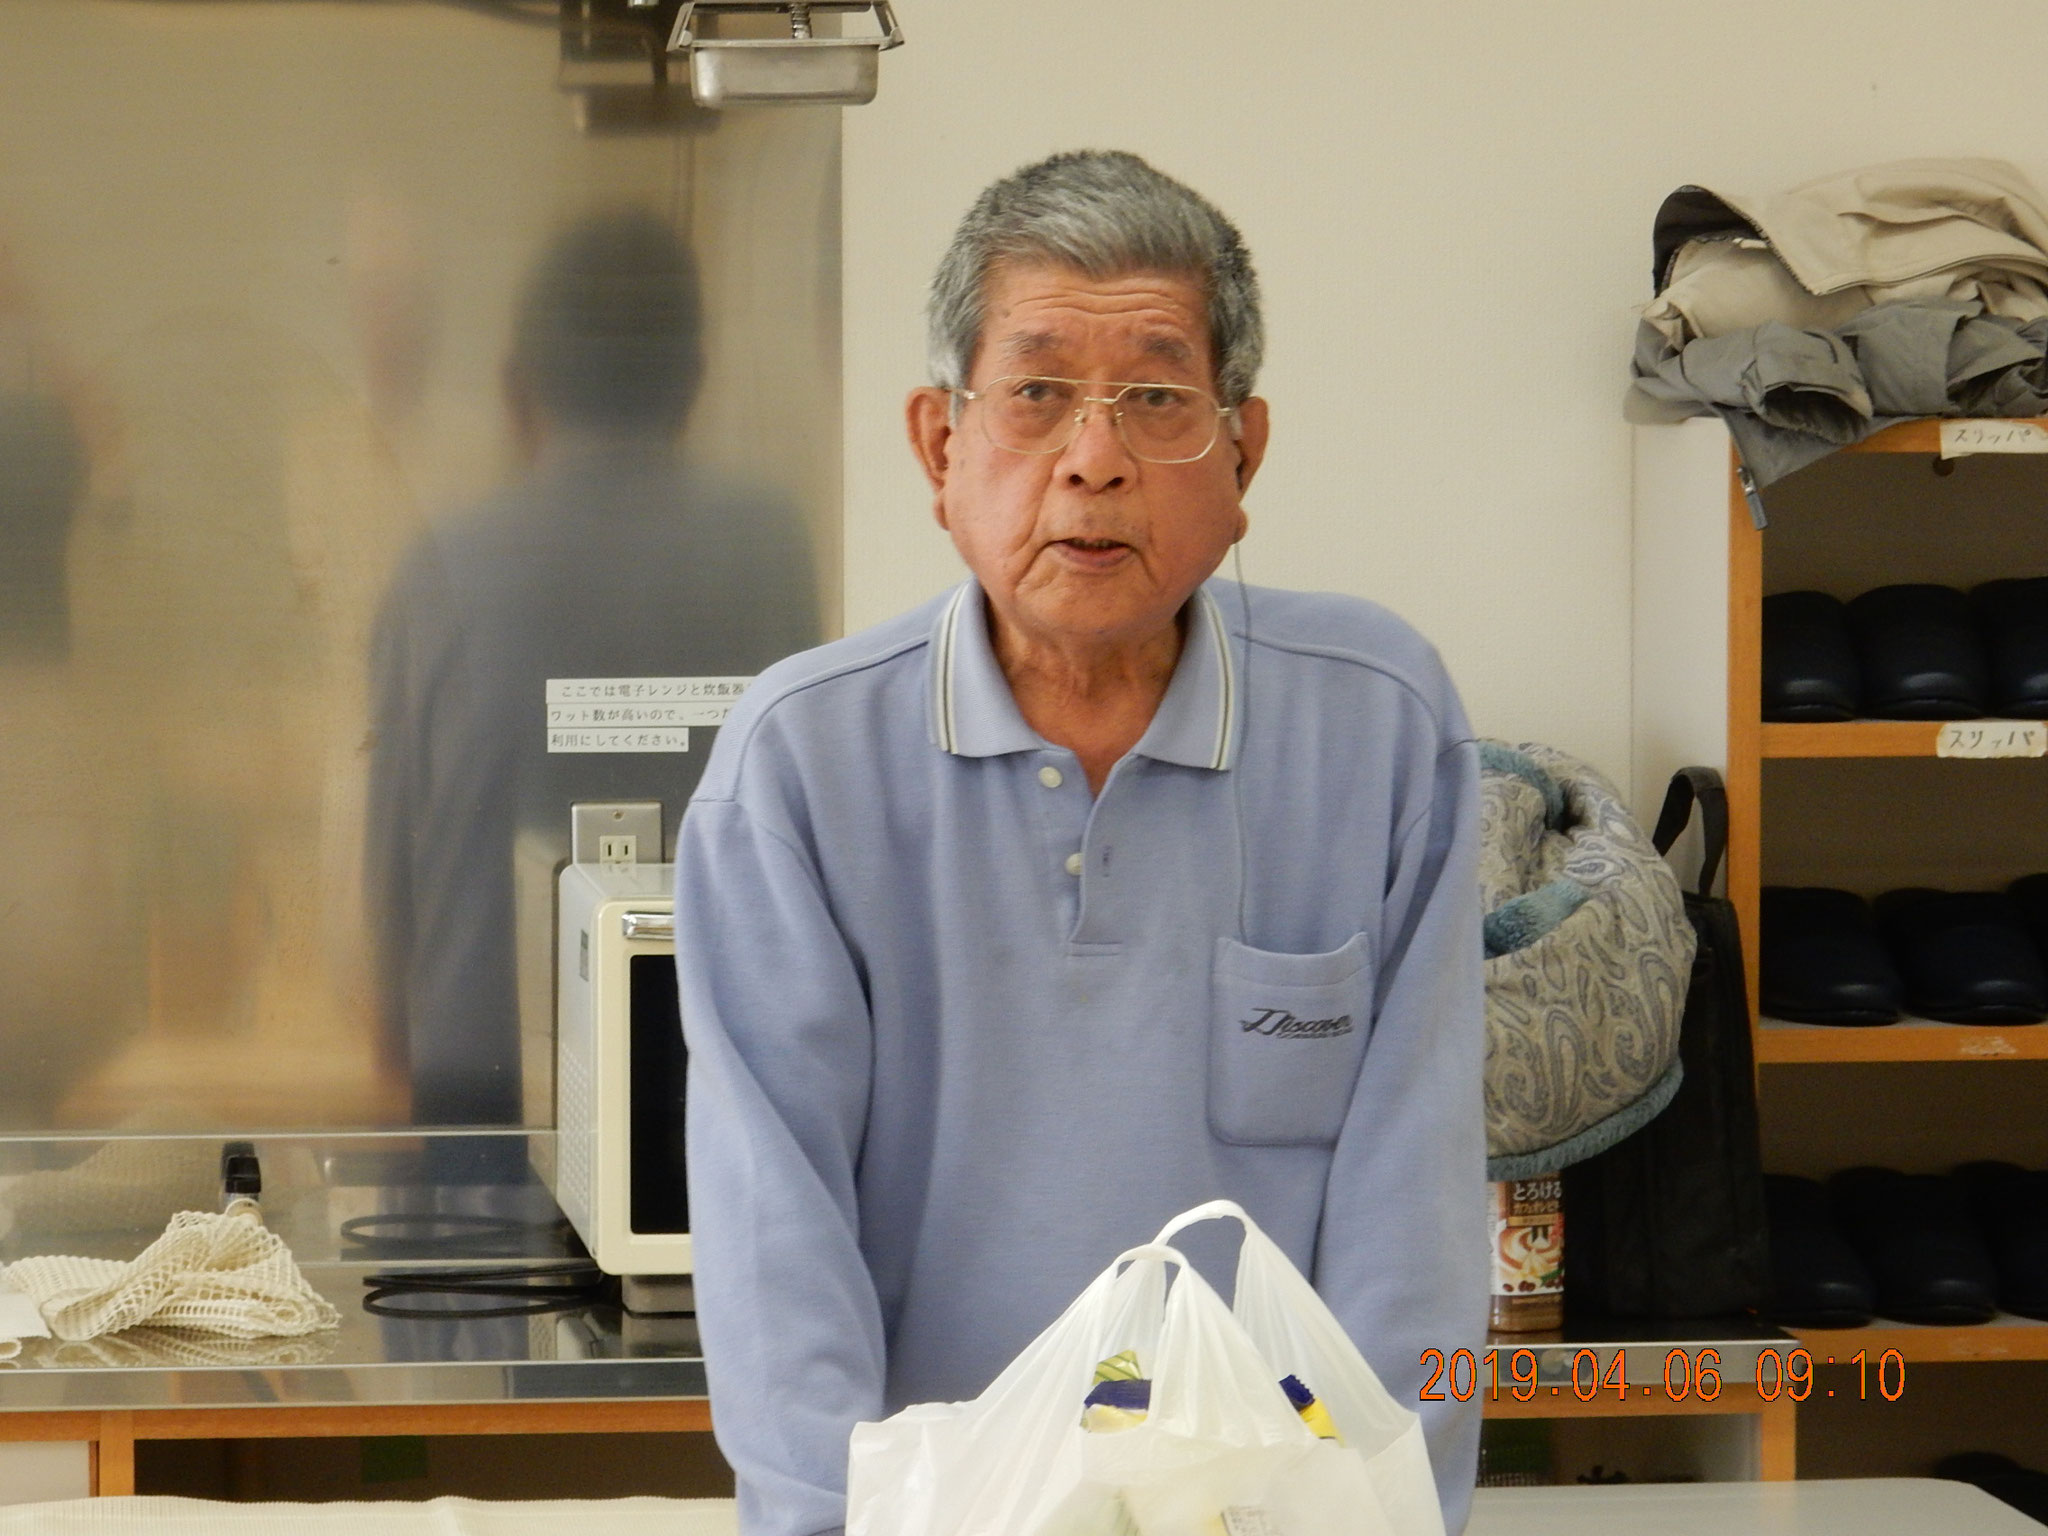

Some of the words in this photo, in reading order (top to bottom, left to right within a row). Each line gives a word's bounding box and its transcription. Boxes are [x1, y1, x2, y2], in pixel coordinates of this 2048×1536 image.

[561, 683, 751, 698] ここでは電子レンジと炊飯器
[551, 733, 686, 747] 利用にしてください。
[1513, 1181, 1562, 1201] とろける
